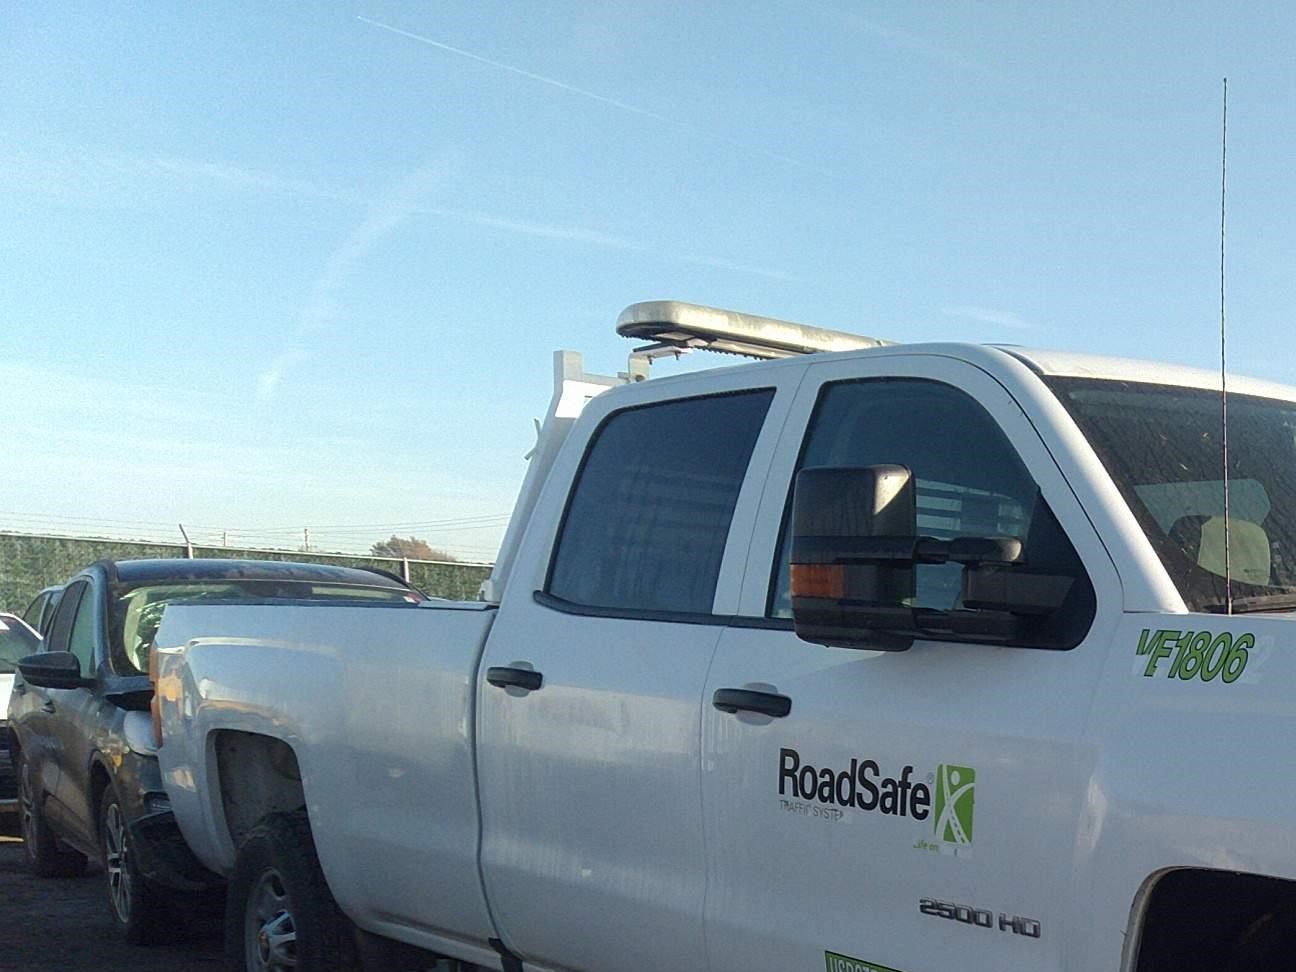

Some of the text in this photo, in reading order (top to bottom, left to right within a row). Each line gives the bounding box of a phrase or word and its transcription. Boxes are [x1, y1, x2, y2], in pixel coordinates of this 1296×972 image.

[1136, 629, 1256, 684] VF1806
[777, 747, 931, 821] RoadSafe
[919, 897, 1041, 939] 2500 HD
